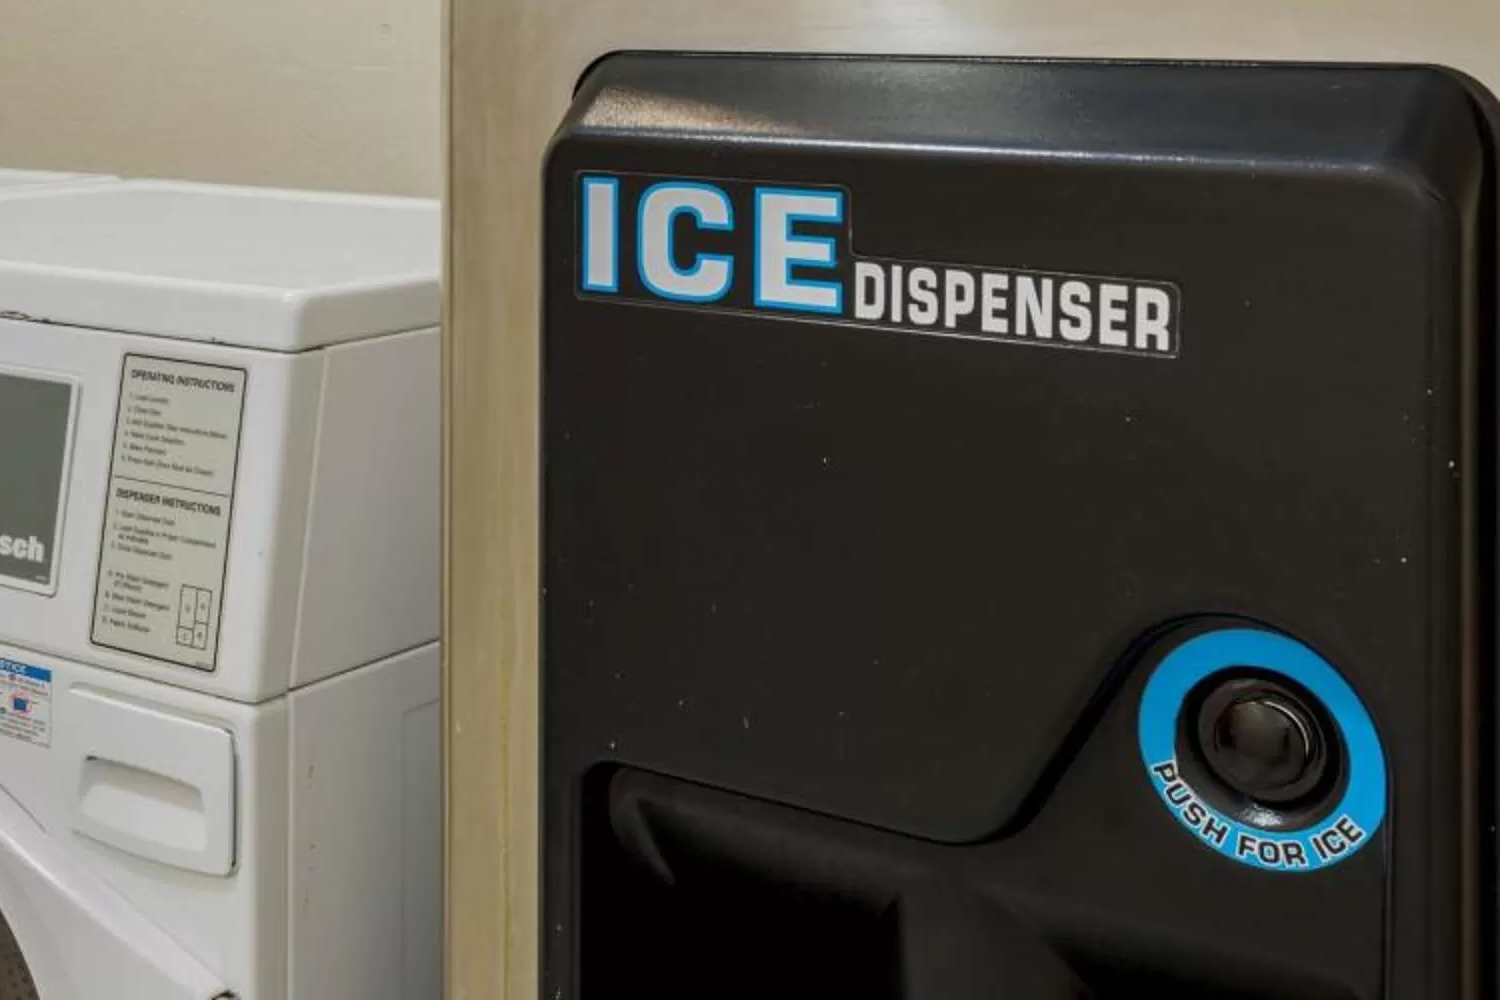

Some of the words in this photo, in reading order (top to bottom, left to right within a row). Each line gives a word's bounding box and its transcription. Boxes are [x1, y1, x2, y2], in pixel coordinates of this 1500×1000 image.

[581, 176, 844, 314] ICE
[854, 261, 1171, 352] DISPENSER
[131, 369, 175, 385] OPERATING
[176, 375, 236, 393] INSTRUCTIONS
[161, 496, 221, 517] INSTRUCTIONS
[1151, 759, 1230, 848] PUSH
[1236, 833, 1309, 868] FOR
[1309, 814, 1367, 862] ICE
